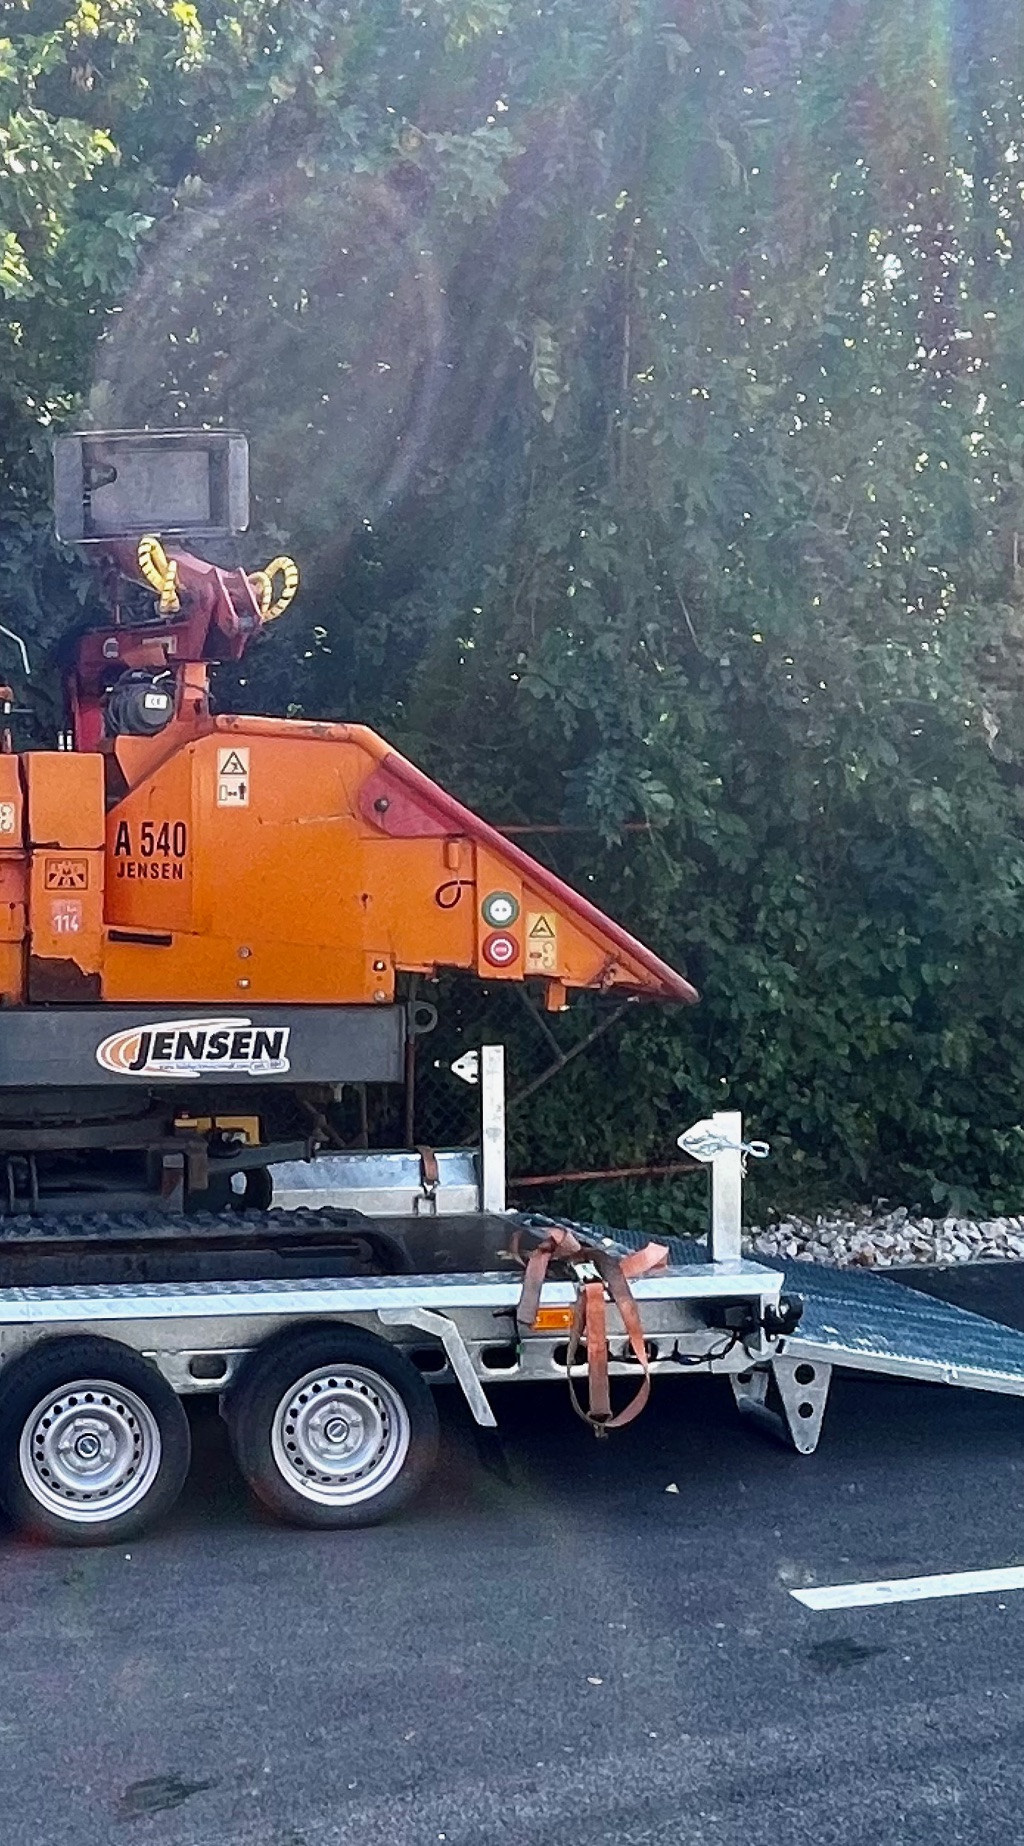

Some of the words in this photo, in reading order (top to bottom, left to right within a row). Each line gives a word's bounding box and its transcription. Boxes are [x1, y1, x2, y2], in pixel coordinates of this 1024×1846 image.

[114, 821, 131, 856] A
[141, 822, 185, 857] 540
[117, 862, 183, 879] JENSEN
[54, 915, 79, 932] 114
[129, 1031, 284, 1071] JENSEN
